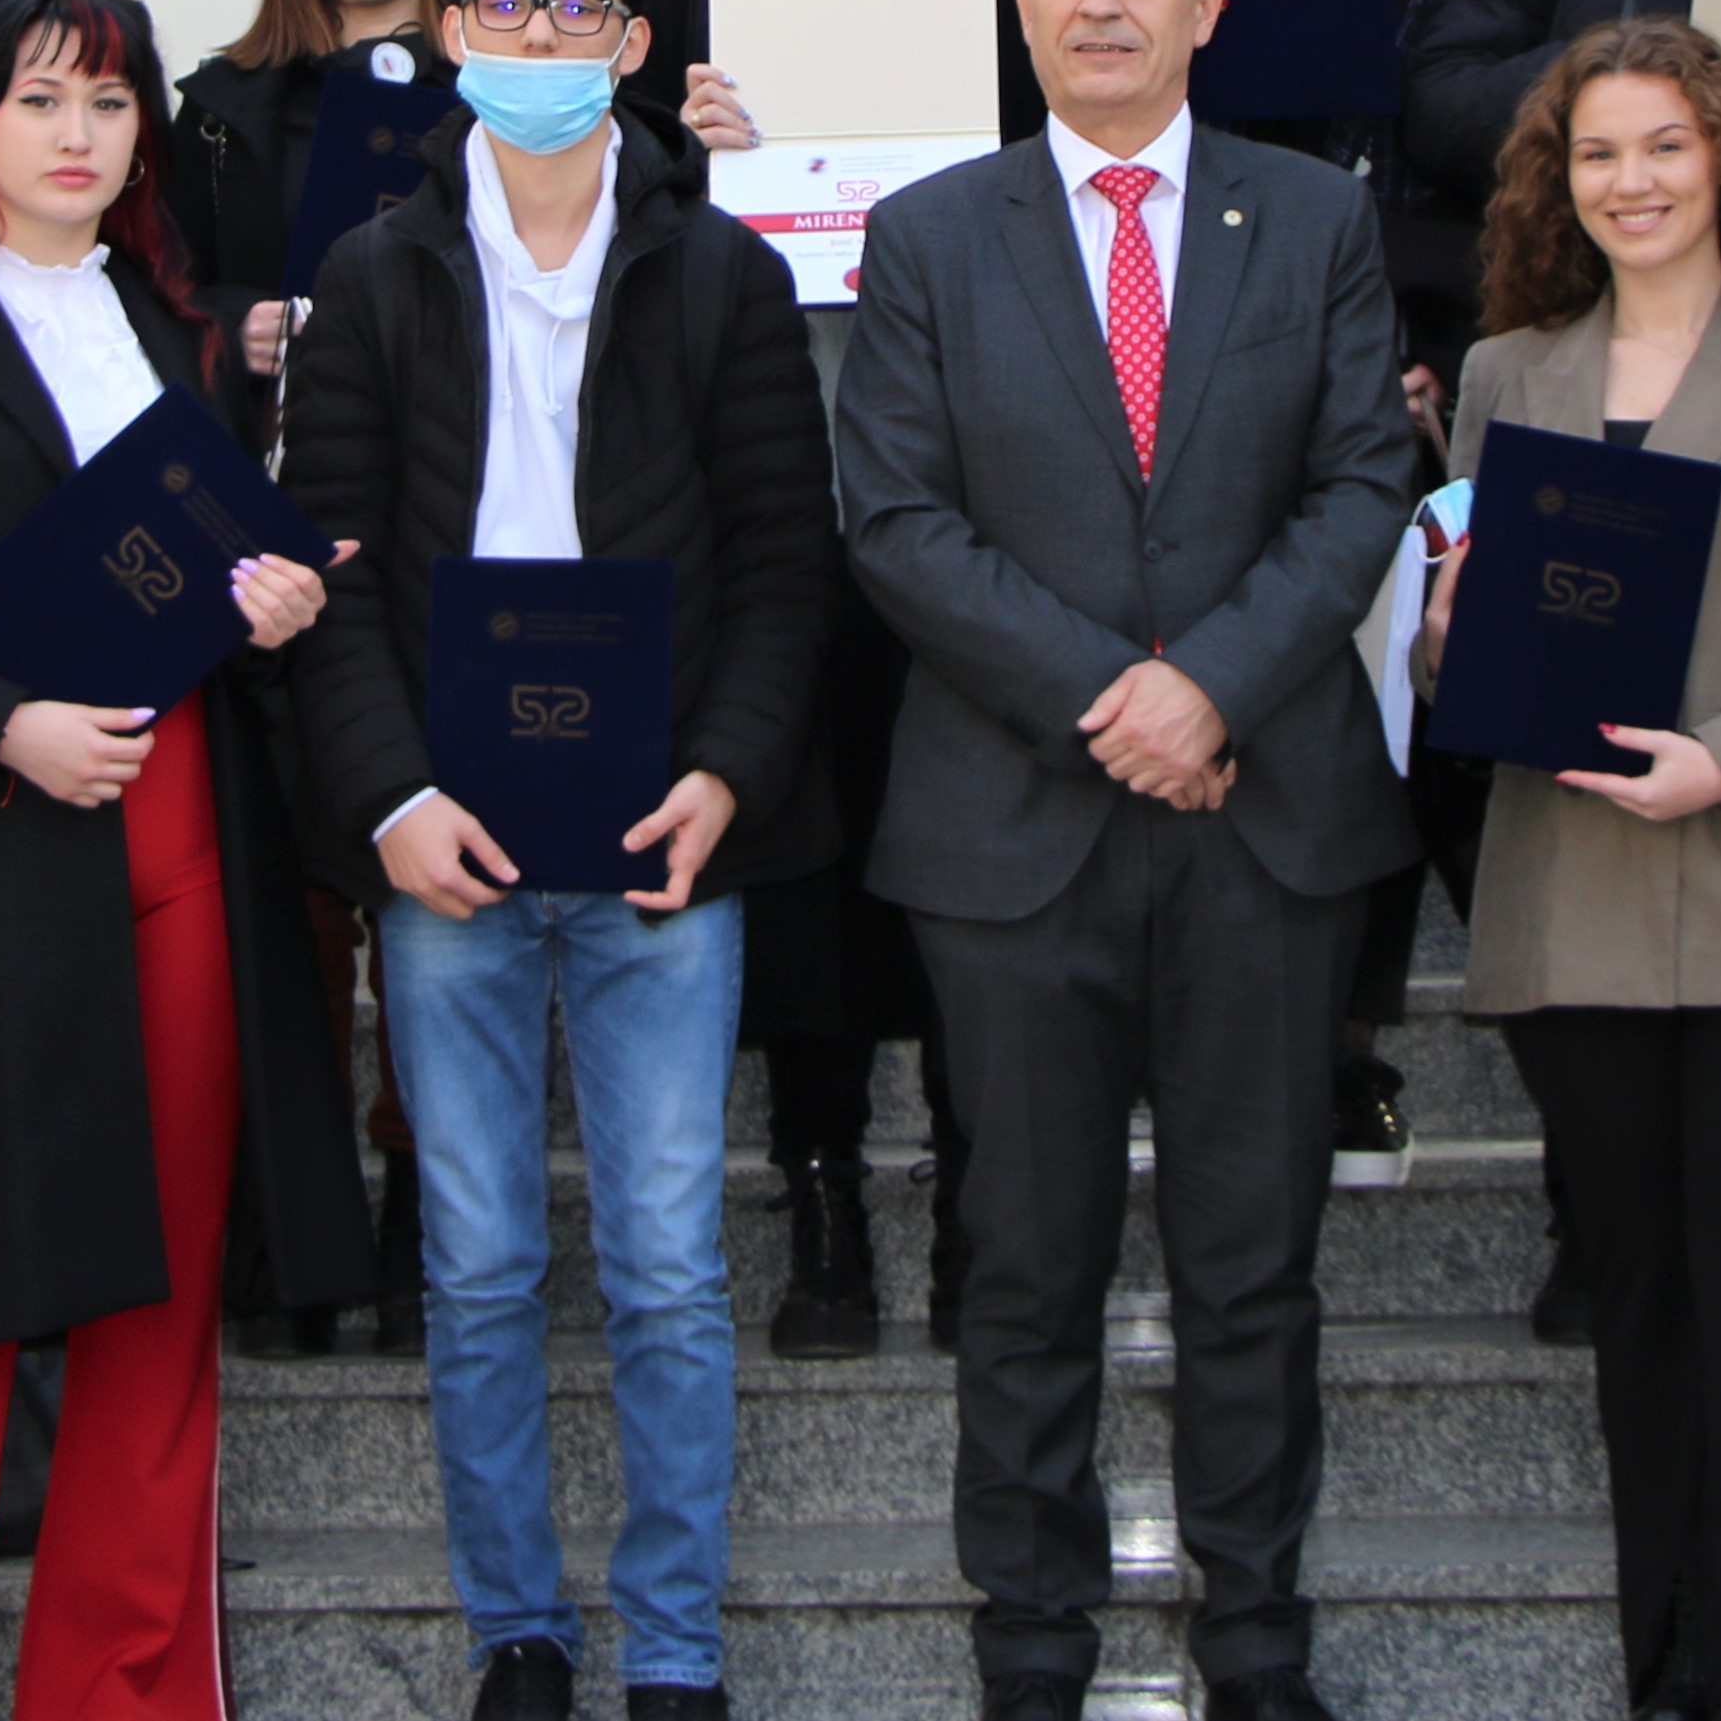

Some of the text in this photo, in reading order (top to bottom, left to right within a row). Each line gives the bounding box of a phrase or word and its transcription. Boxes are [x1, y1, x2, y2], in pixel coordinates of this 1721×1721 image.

[836, 180, 880, 203] 52
[793, 211, 866, 229] MIRËN
[510, 684, 591, 740] 52
